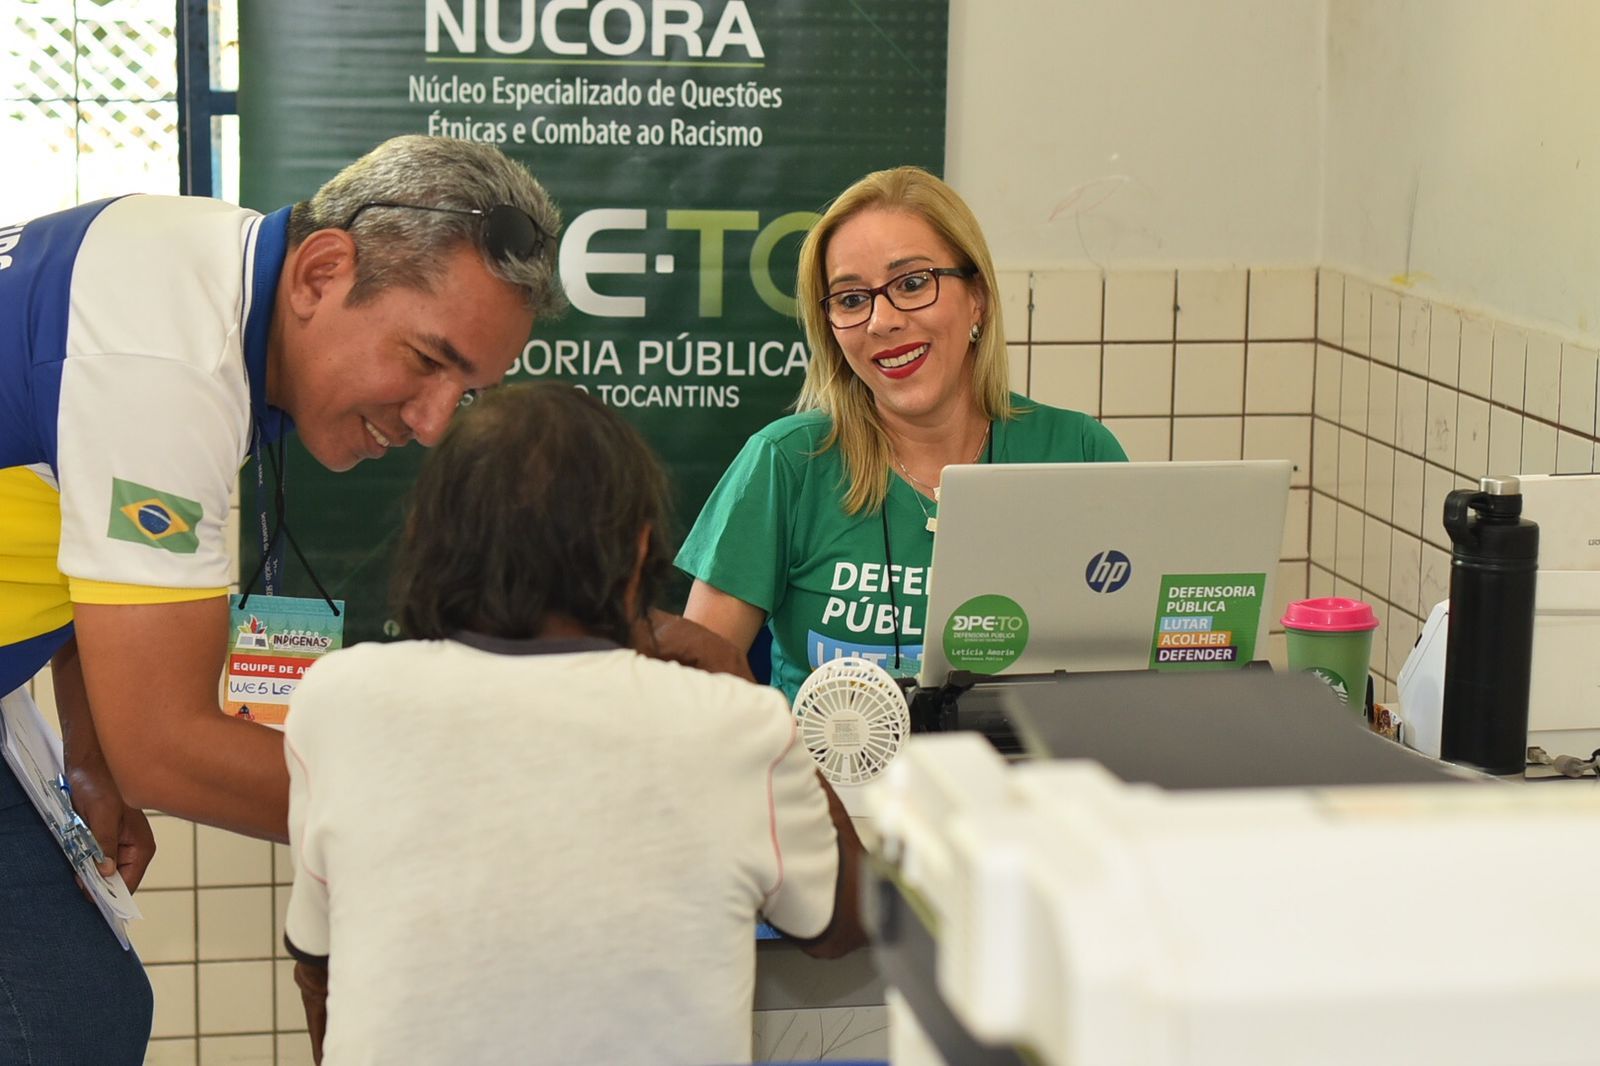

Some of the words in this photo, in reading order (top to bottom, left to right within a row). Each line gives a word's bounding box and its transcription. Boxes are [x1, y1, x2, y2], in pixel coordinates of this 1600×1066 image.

[425, 0, 766, 58] NUCORA
[408, 74, 486, 105] Núcleo
[492, 76, 642, 111] Especializado
[647, 78, 675, 108] de
[681, 78, 783, 110] Questões
[427, 109, 507, 144] Étnicas
[512, 120, 526, 145] e
[531, 117, 631, 145] Combate
[636, 123, 664, 146] ao
[670, 117, 763, 148] Racismo
[639, 332, 809, 377] PÚBLICA
[597, 384, 740, 409] TOCANTINS
[1088, 550, 1130, 593] hp
[1168, 585, 1256, 599] DEFENSORIA
[1166, 599, 1226, 613] PÚBLICA
[1163, 618, 1209, 631] LUTAR
[990, 632, 1016, 640] PÚBLICA
[1160, 633, 1226, 646] ACOLHER
[1158, 648, 1233, 662] DEFENDER
[233, 662, 276, 673] EQUIPE
[279, 666, 294, 674] DE
